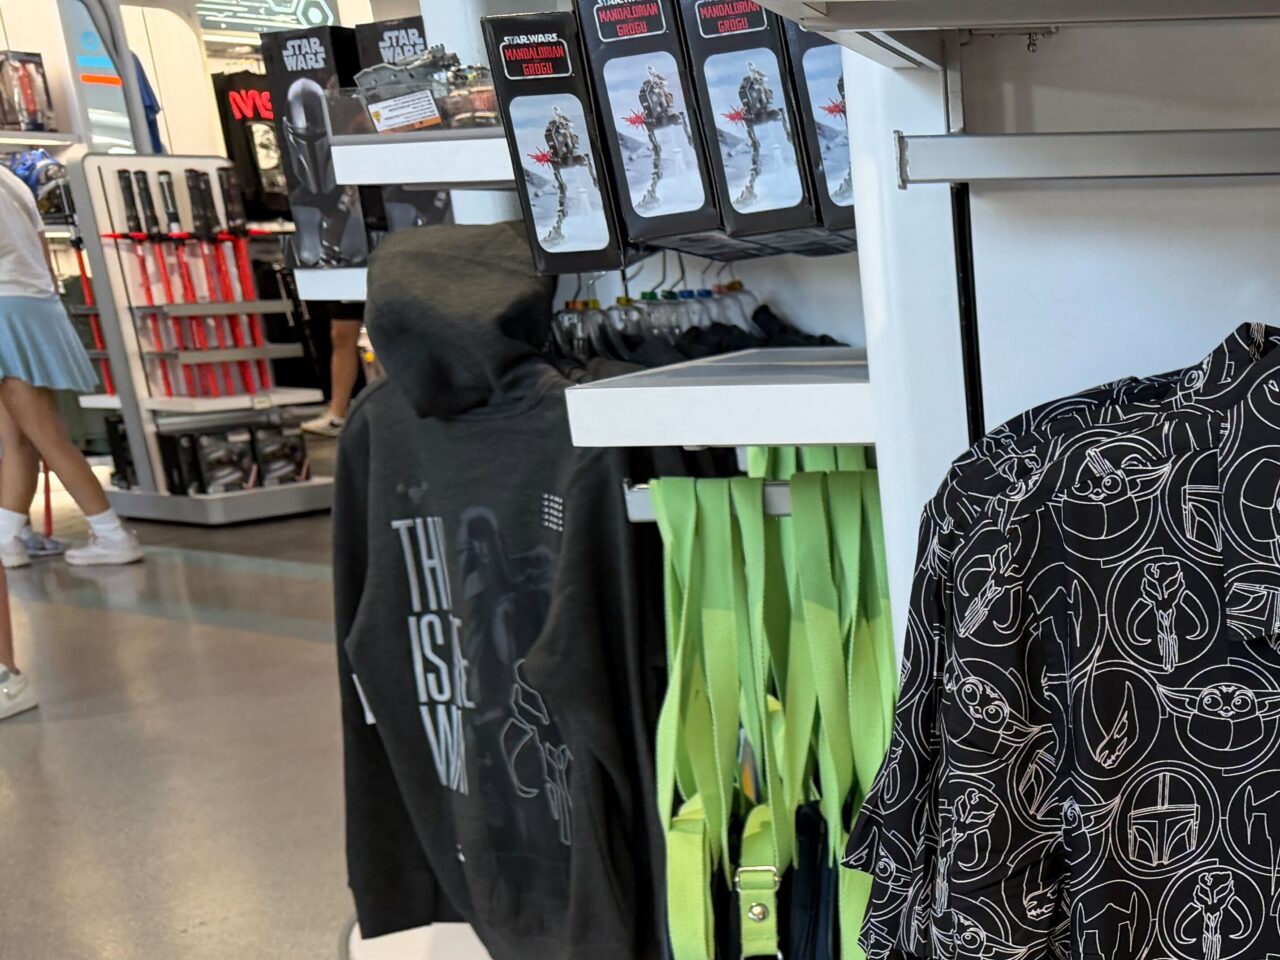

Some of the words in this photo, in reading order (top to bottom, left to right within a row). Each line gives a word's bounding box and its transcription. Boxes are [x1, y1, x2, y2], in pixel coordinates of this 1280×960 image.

[599, 3, 658, 22] MANDALORIAN
[617, 21, 647, 36] GROGU
[718, 18, 748, 32] GROGU
[282, 37, 325, 55] STAR
[379, 28, 424, 47] STAR
[504, 36, 530, 45] STAR
[528, 33, 558, 43] WARS
[282, 52, 326, 72] WARS
[504, 46, 565, 60] MANDALORIAN
[522, 62, 553, 75] GROGU
[391, 516, 452, 612] THI
[408, 614, 451, 703] IS
